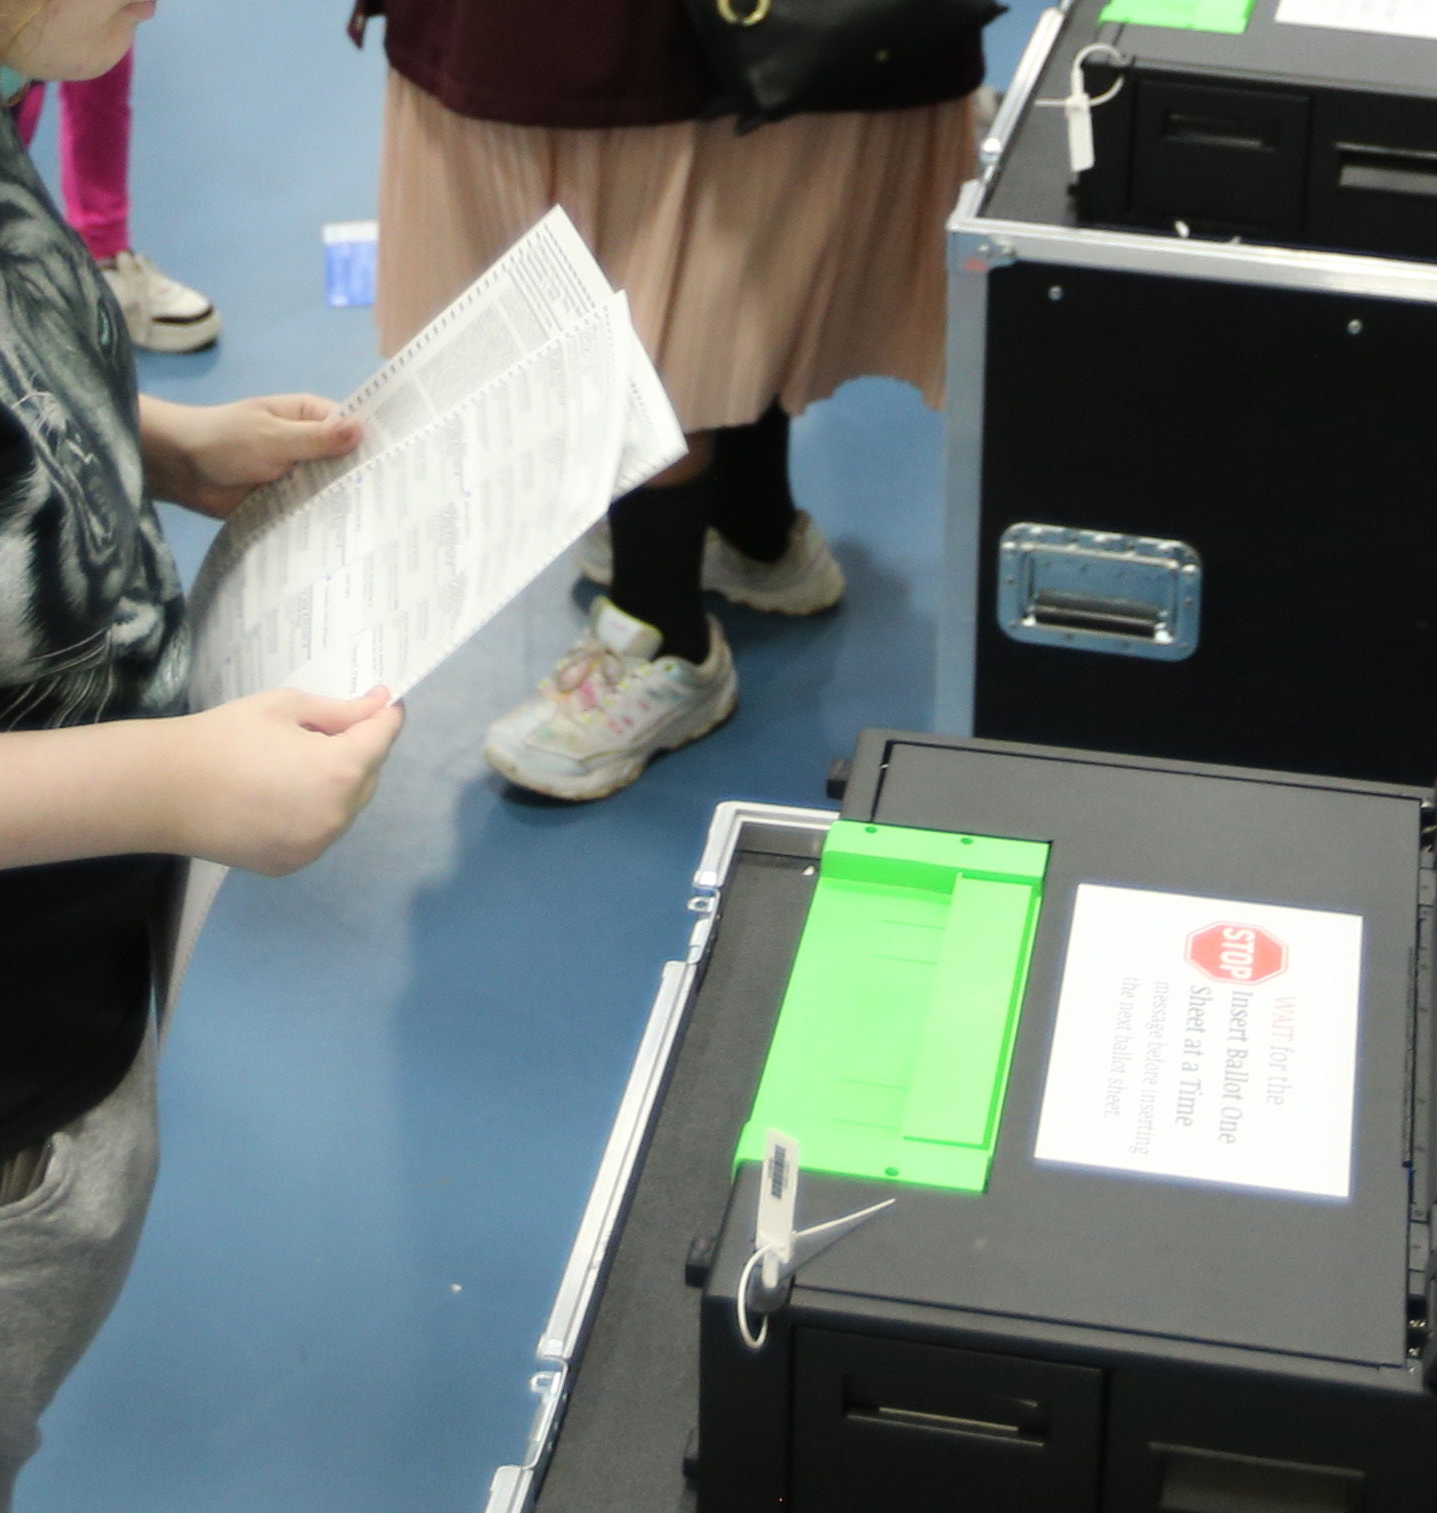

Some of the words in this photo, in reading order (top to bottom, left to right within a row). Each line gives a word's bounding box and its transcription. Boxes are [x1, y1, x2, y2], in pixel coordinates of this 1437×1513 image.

[1220, 927, 1256, 980] STOP
[1119, 977, 1142, 999] the
[1144, 981, 1170, 1039] message
[1185, 984, 1214, 1034] Sheet
[1115, 1001, 1135, 1032] next
[1227, 990, 1254, 1043] Insert
[1271, 995, 1297, 1042] WAIT
[1109, 1034, 1136, 1074] ballot
[1141, 1041, 1169, 1086] before
[1180, 1061, 1200, 1072] a
[1182, 1038, 1204, 1057] at
[1269, 1045, 1296, 1071] for
[1221, 1048, 1249, 1101] Ballot
[1265, 1076, 1292, 1105] the
[1128, 1088, 1162, 1155] inserting
[1174, 1079, 1204, 1127] Time
[1218, 1106, 1243, 1144] One
